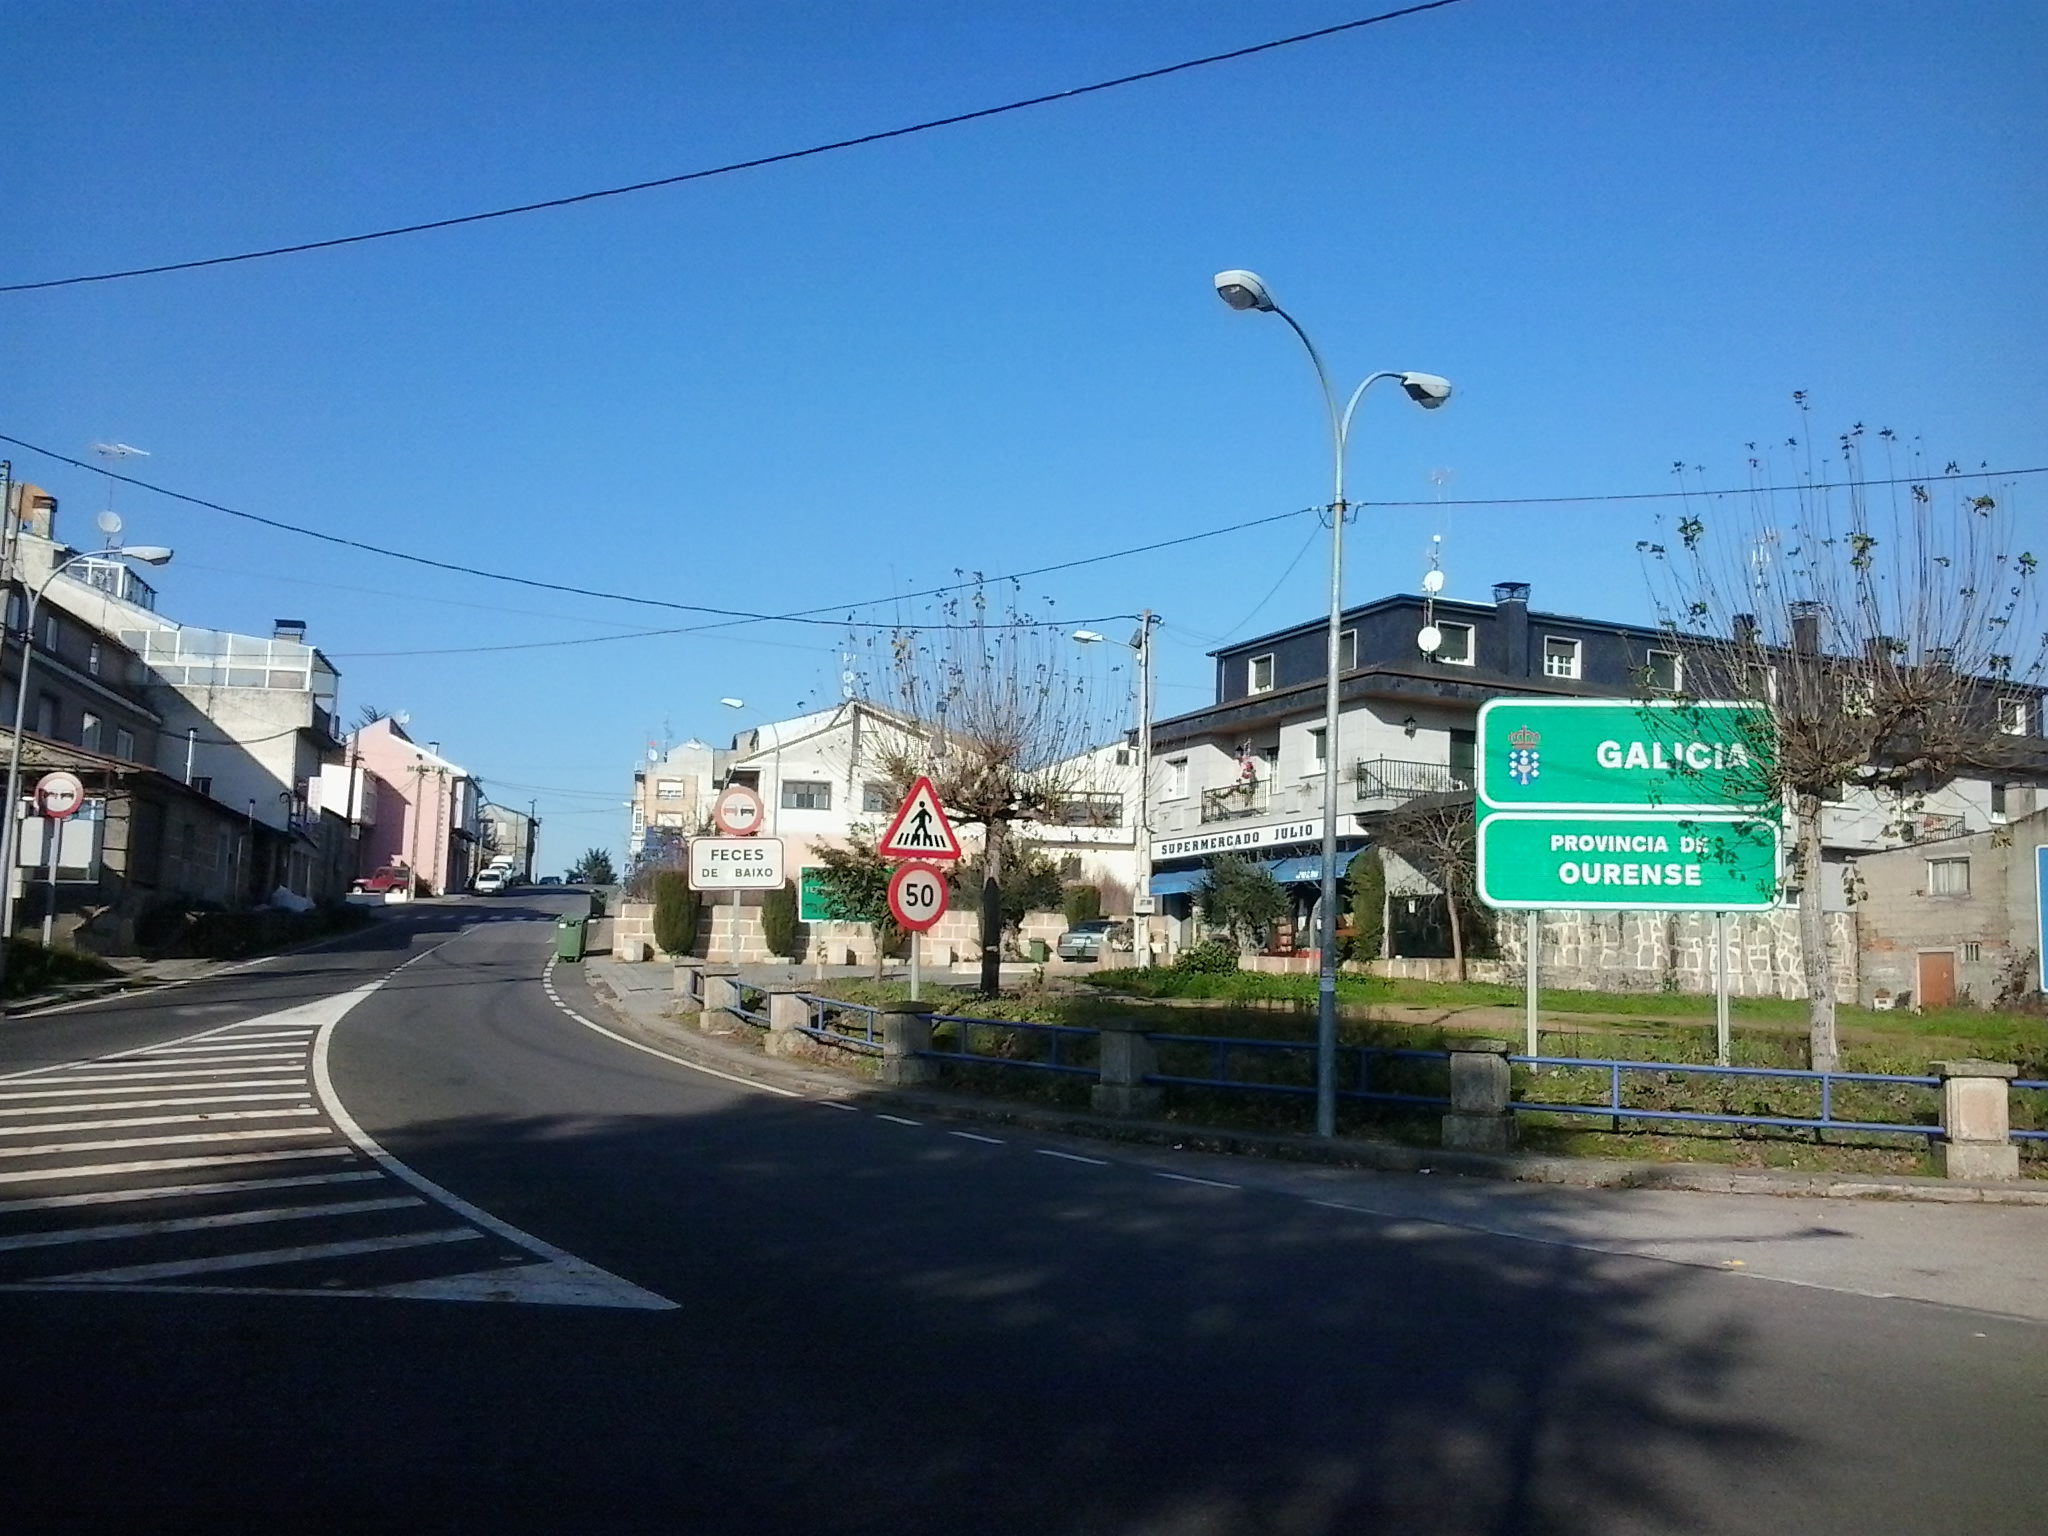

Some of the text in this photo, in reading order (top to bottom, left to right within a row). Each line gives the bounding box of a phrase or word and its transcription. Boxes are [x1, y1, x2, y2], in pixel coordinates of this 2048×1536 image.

[1596, 739, 1750, 770] GALICIA
[1161, 824, 1313, 856] SUPERMERCADO JULIO
[1550, 834, 1709, 854] PROVINCIA DE
[710, 848, 764, 862] FECES
[701, 866, 774, 878] DE BAIXO
[1558, 862, 1701, 886] OURENSE
[905, 883, 934, 907] 50
